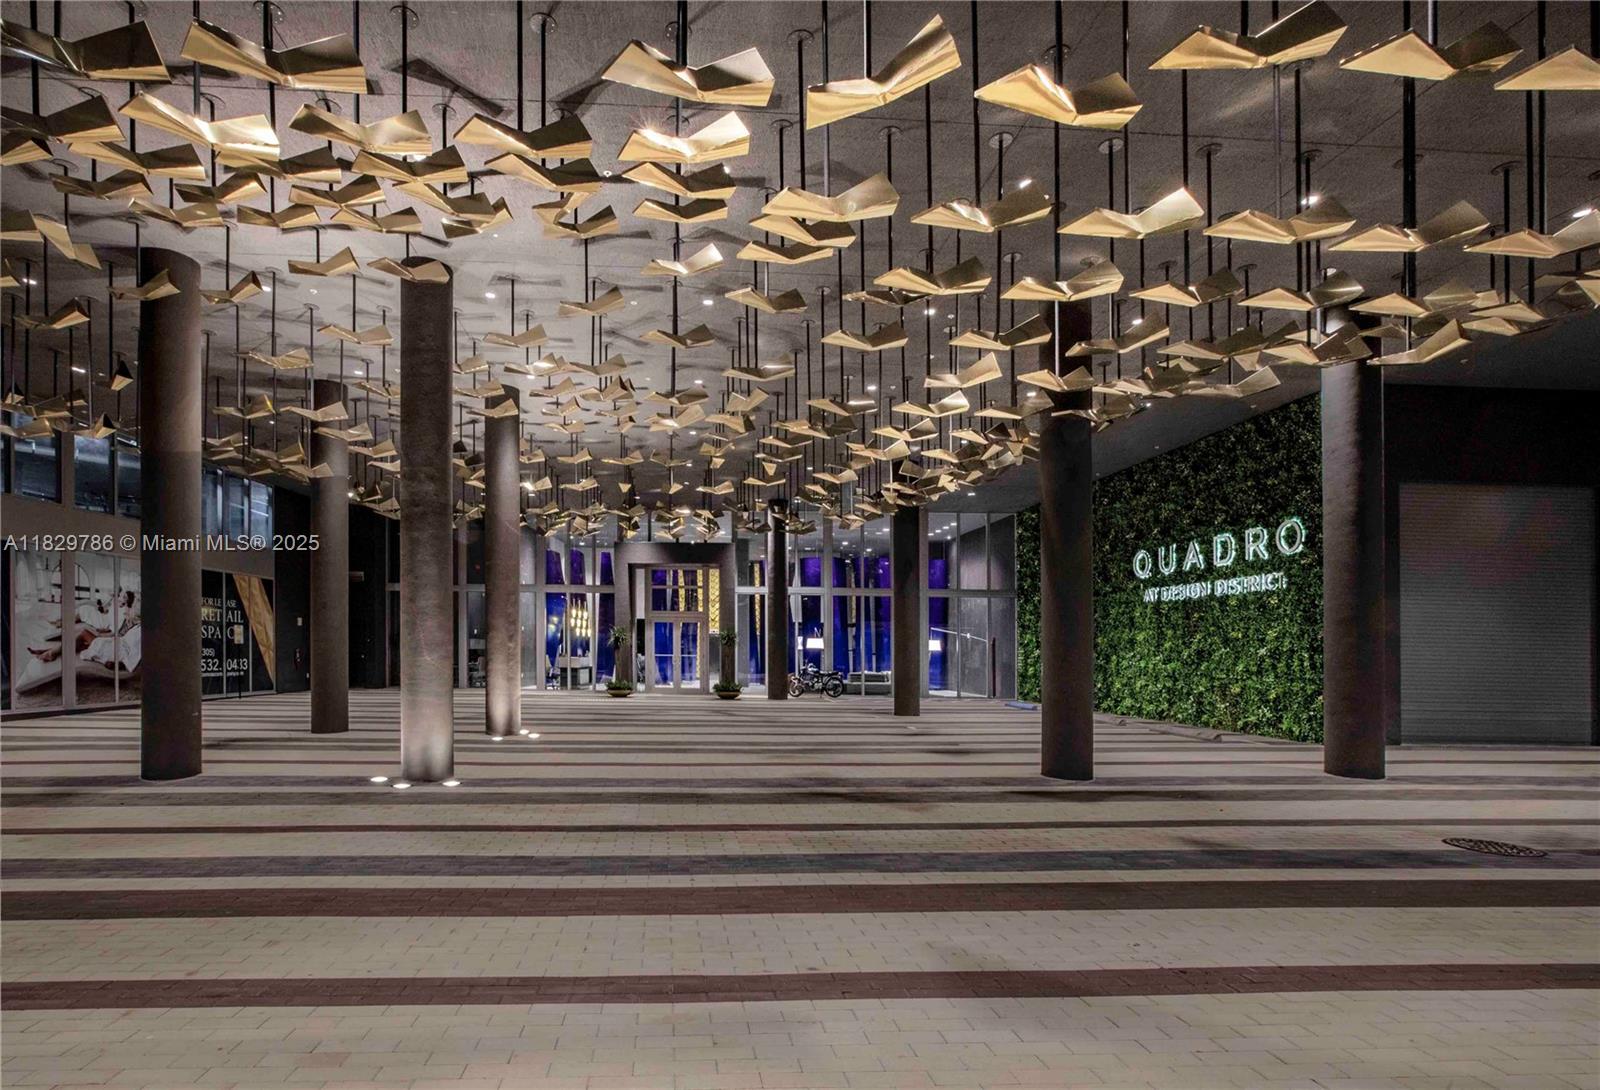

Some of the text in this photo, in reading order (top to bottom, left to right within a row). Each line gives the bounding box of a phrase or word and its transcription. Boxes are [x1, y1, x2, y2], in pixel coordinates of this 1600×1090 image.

[1132, 517, 1306, 579] QUADRO
[1143, 572, 1288, 603] AT DESIGN DISTRICT
[201, 607, 244, 623] RETAIL
[200, 625, 240, 640] SPAC
